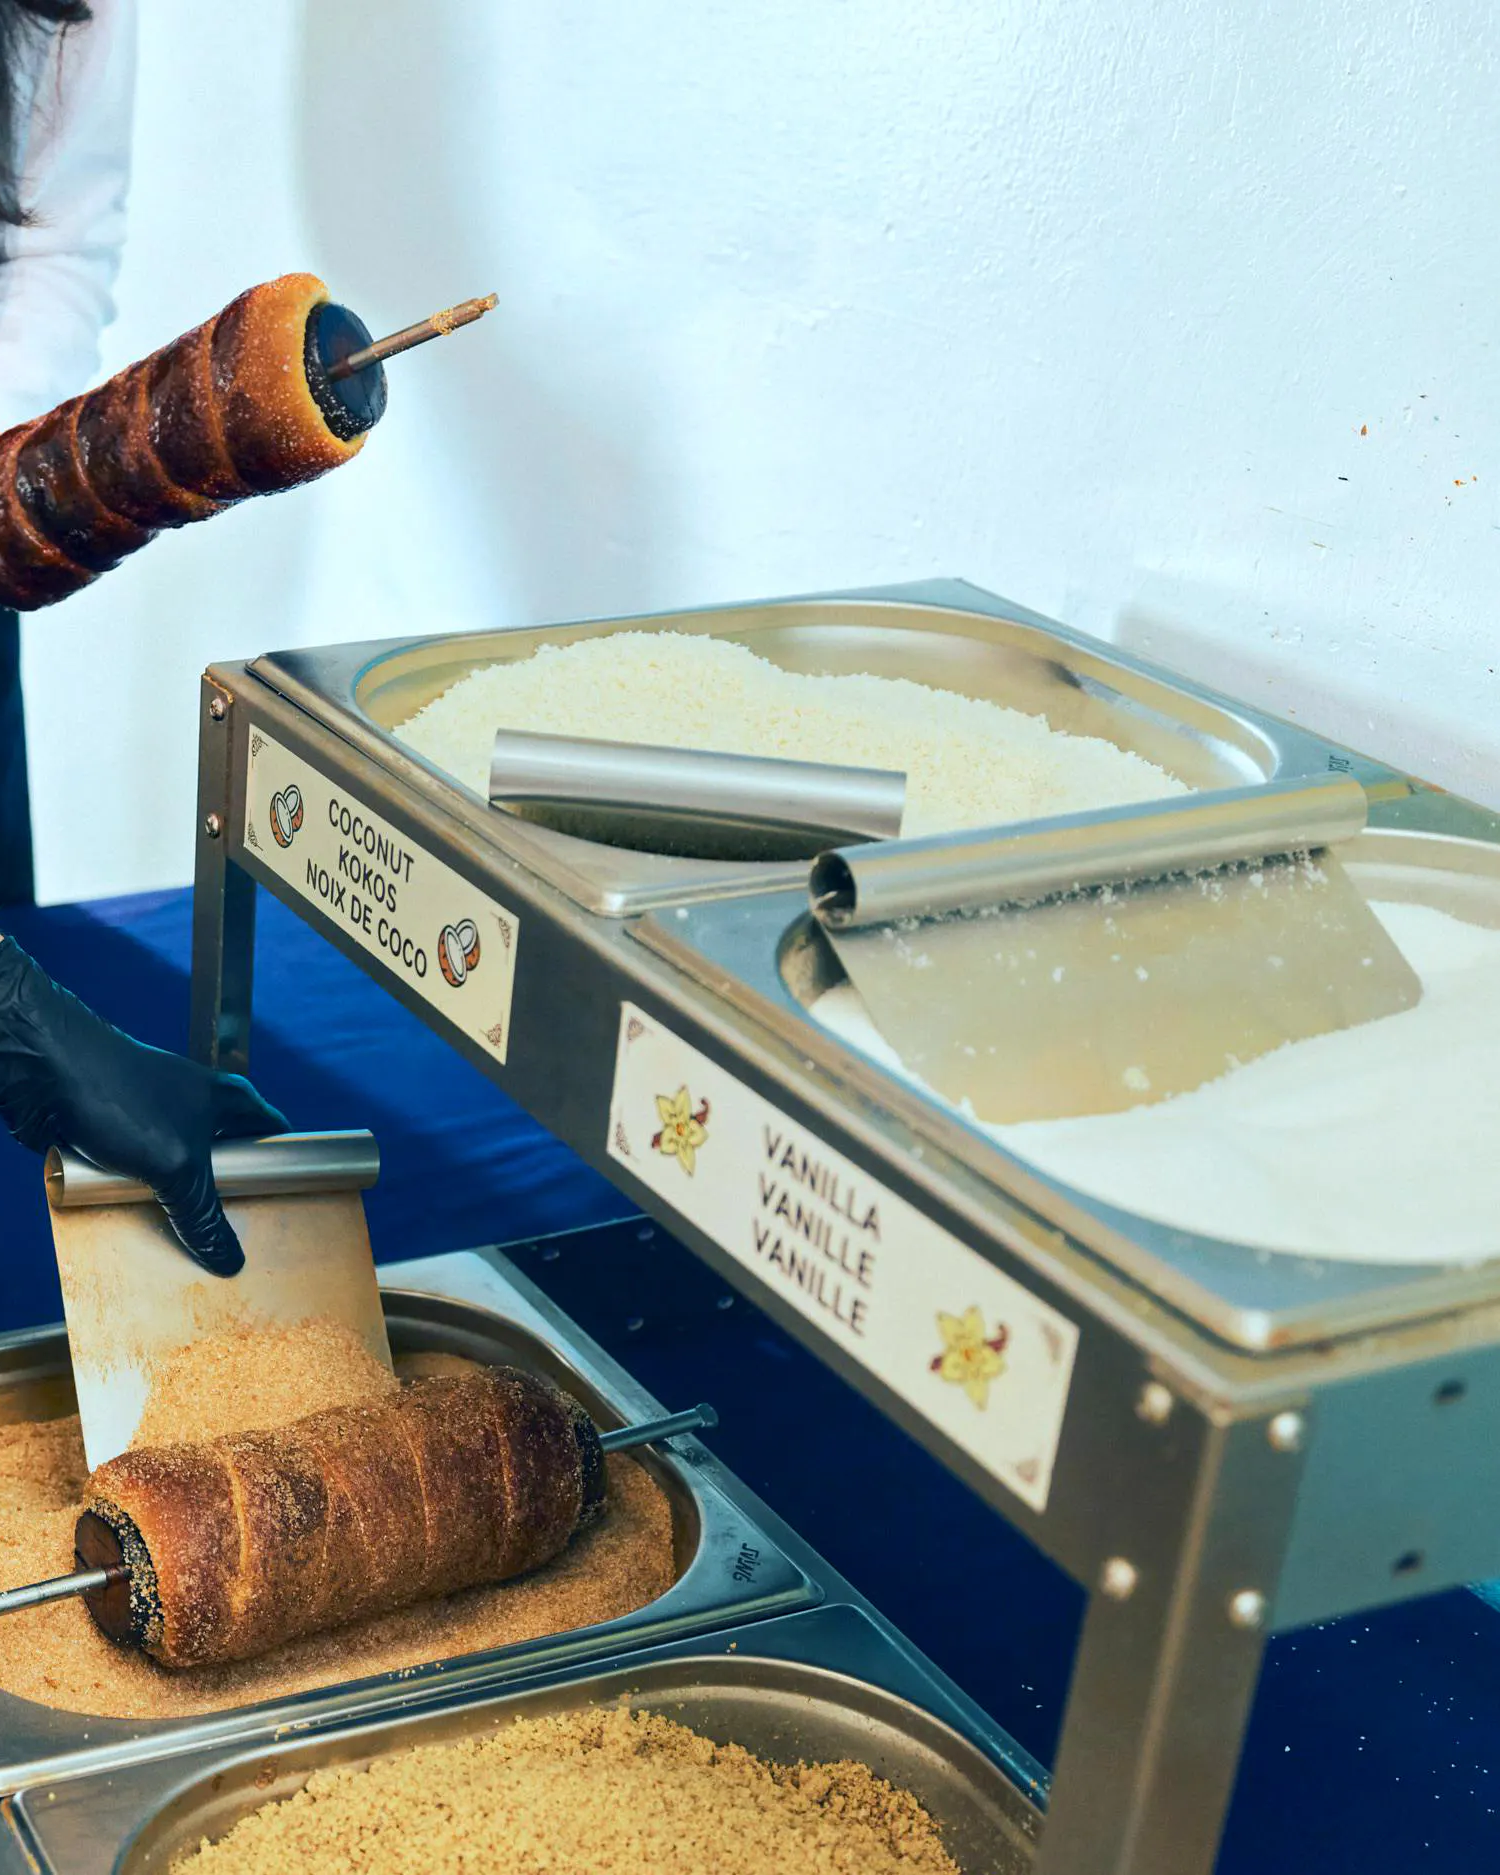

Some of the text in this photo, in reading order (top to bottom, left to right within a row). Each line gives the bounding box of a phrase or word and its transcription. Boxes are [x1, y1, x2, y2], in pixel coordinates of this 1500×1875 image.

[328, 798, 415, 884] COCONUT
[338, 845, 398, 914] KOKOS
[306, 858, 428, 979] NOIX DE COCO
[758, 1170, 874, 1290] VANILLE
[764, 1123, 882, 1244] VANILLA
[753, 1217, 868, 1338] VANILLE
